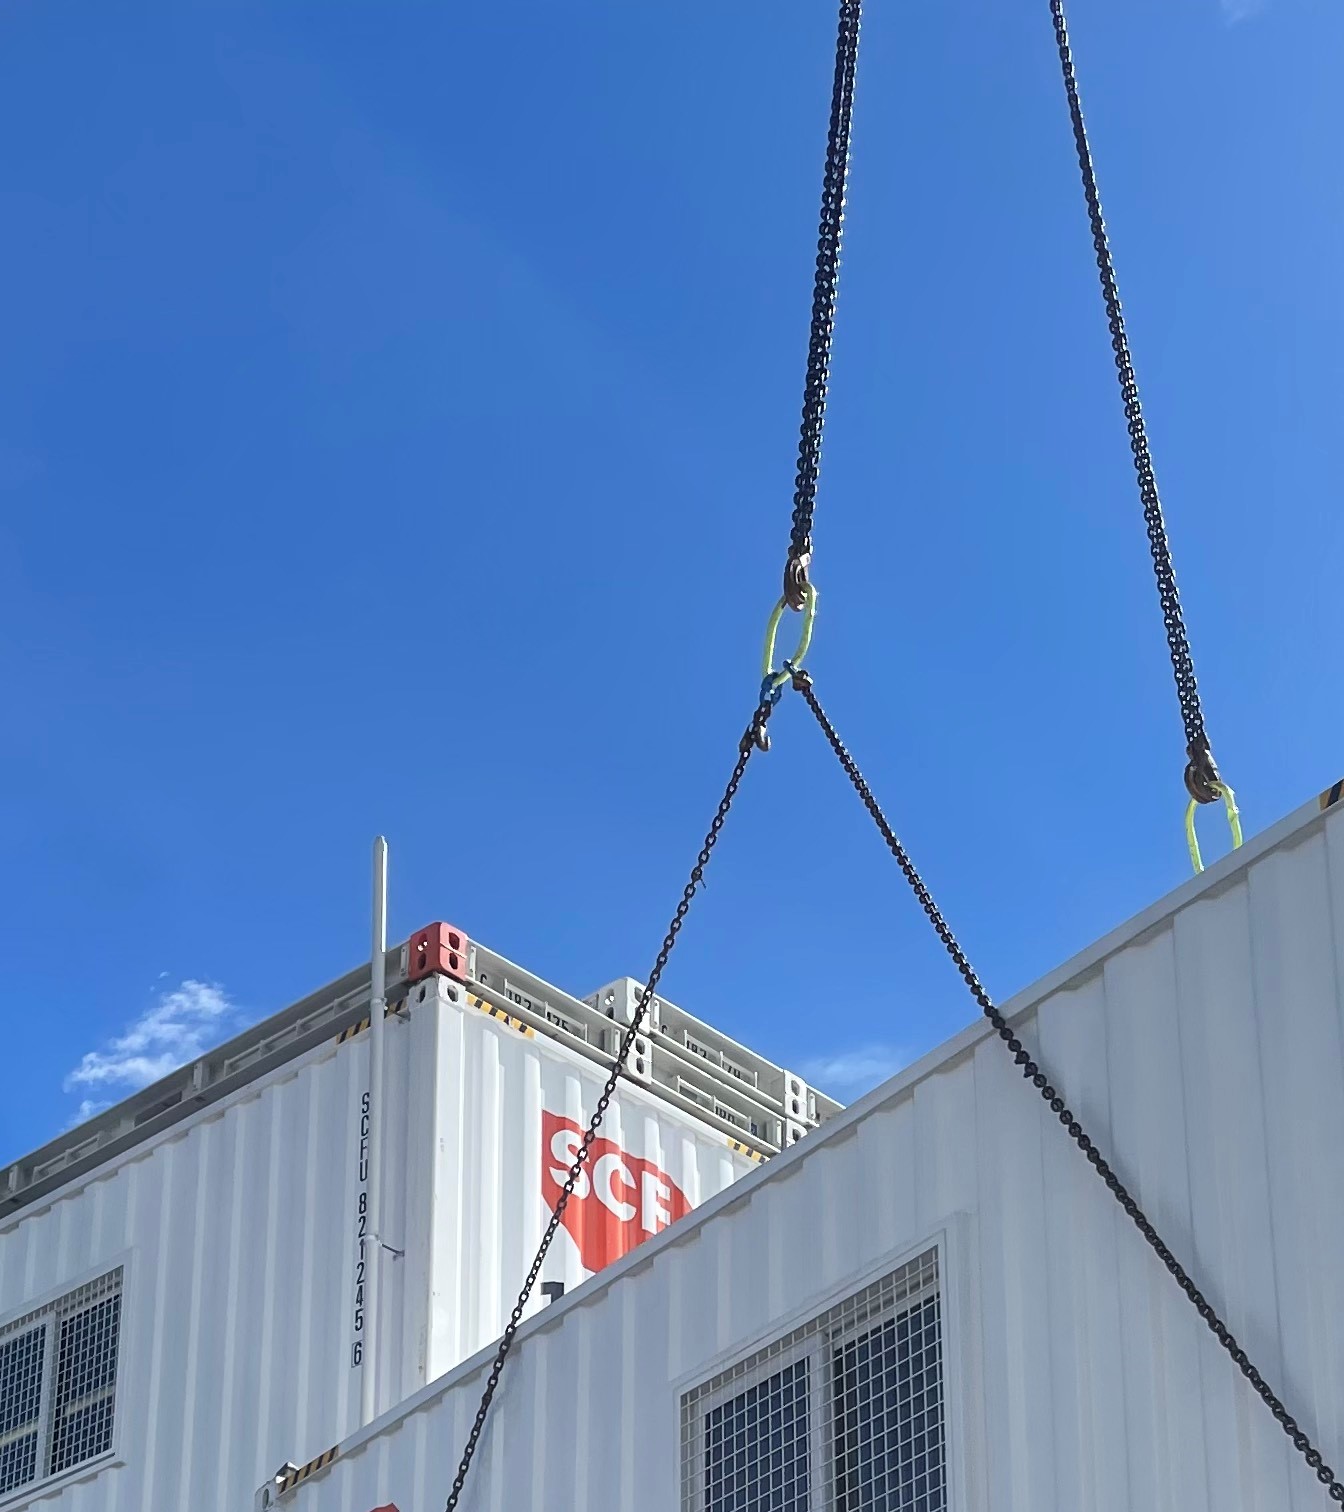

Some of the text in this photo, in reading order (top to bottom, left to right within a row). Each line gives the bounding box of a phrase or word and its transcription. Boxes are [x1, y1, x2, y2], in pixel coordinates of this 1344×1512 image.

[352, 1091, 370, 1367] SCFU 821245 6
[549, 1129, 671, 1235] SCF
